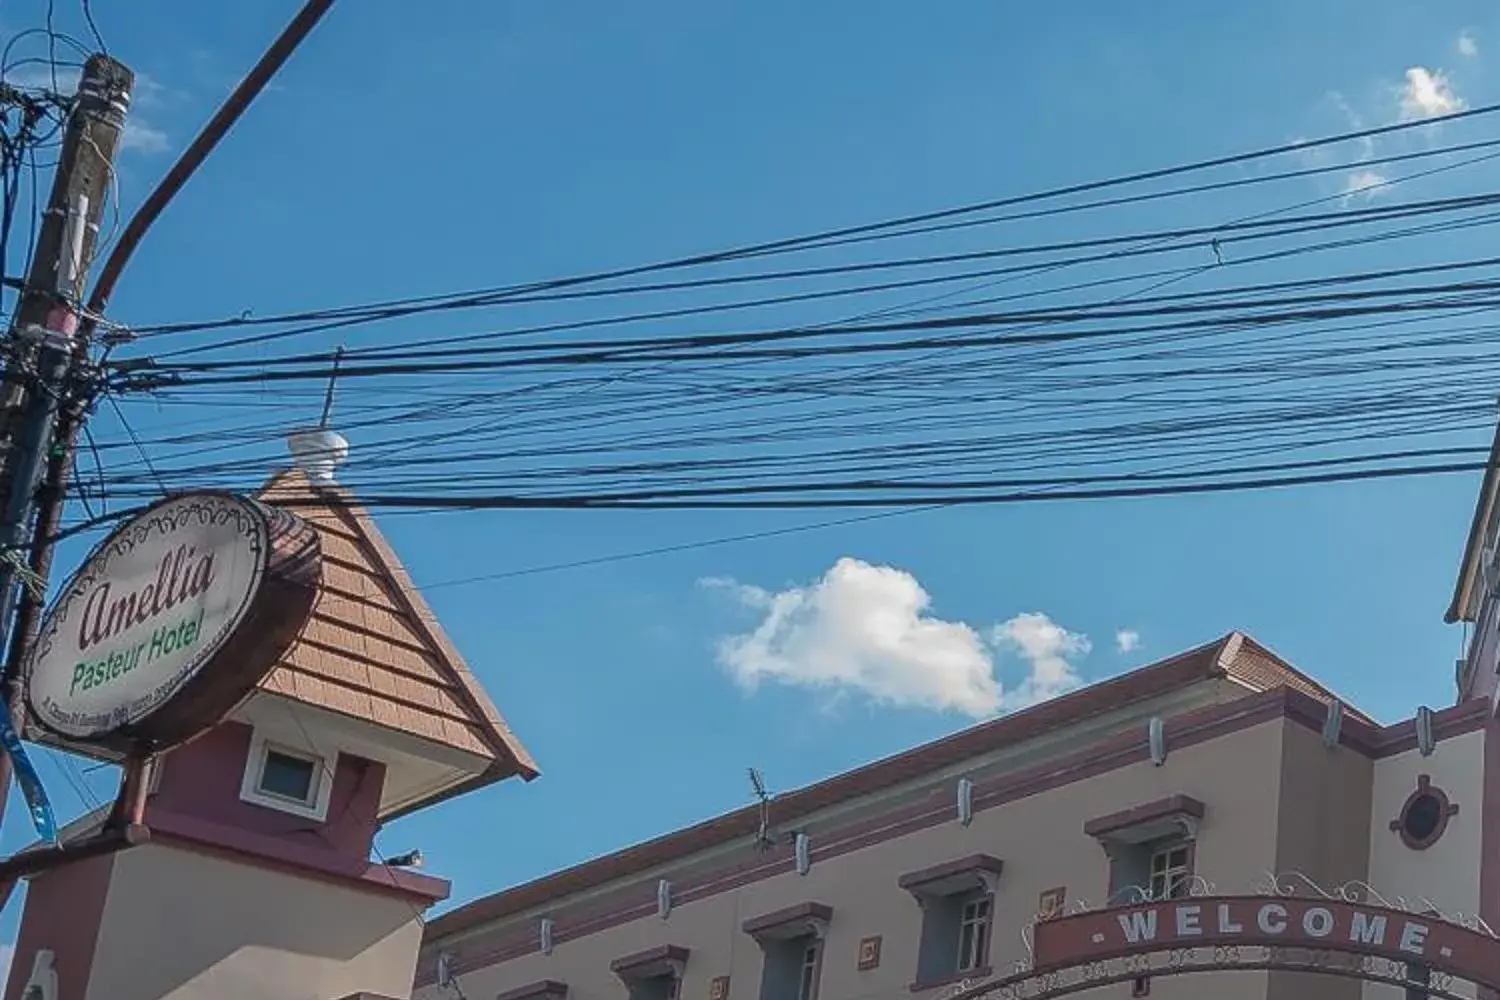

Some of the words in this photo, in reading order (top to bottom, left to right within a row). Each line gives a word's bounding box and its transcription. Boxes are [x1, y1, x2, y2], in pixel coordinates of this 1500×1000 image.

[80, 543, 215, 652] Amellia
[69, 640, 147, 697] Pasteur
[147, 608, 204, 662] Hotel
[1117, 903, 1430, 956] WELCOME
